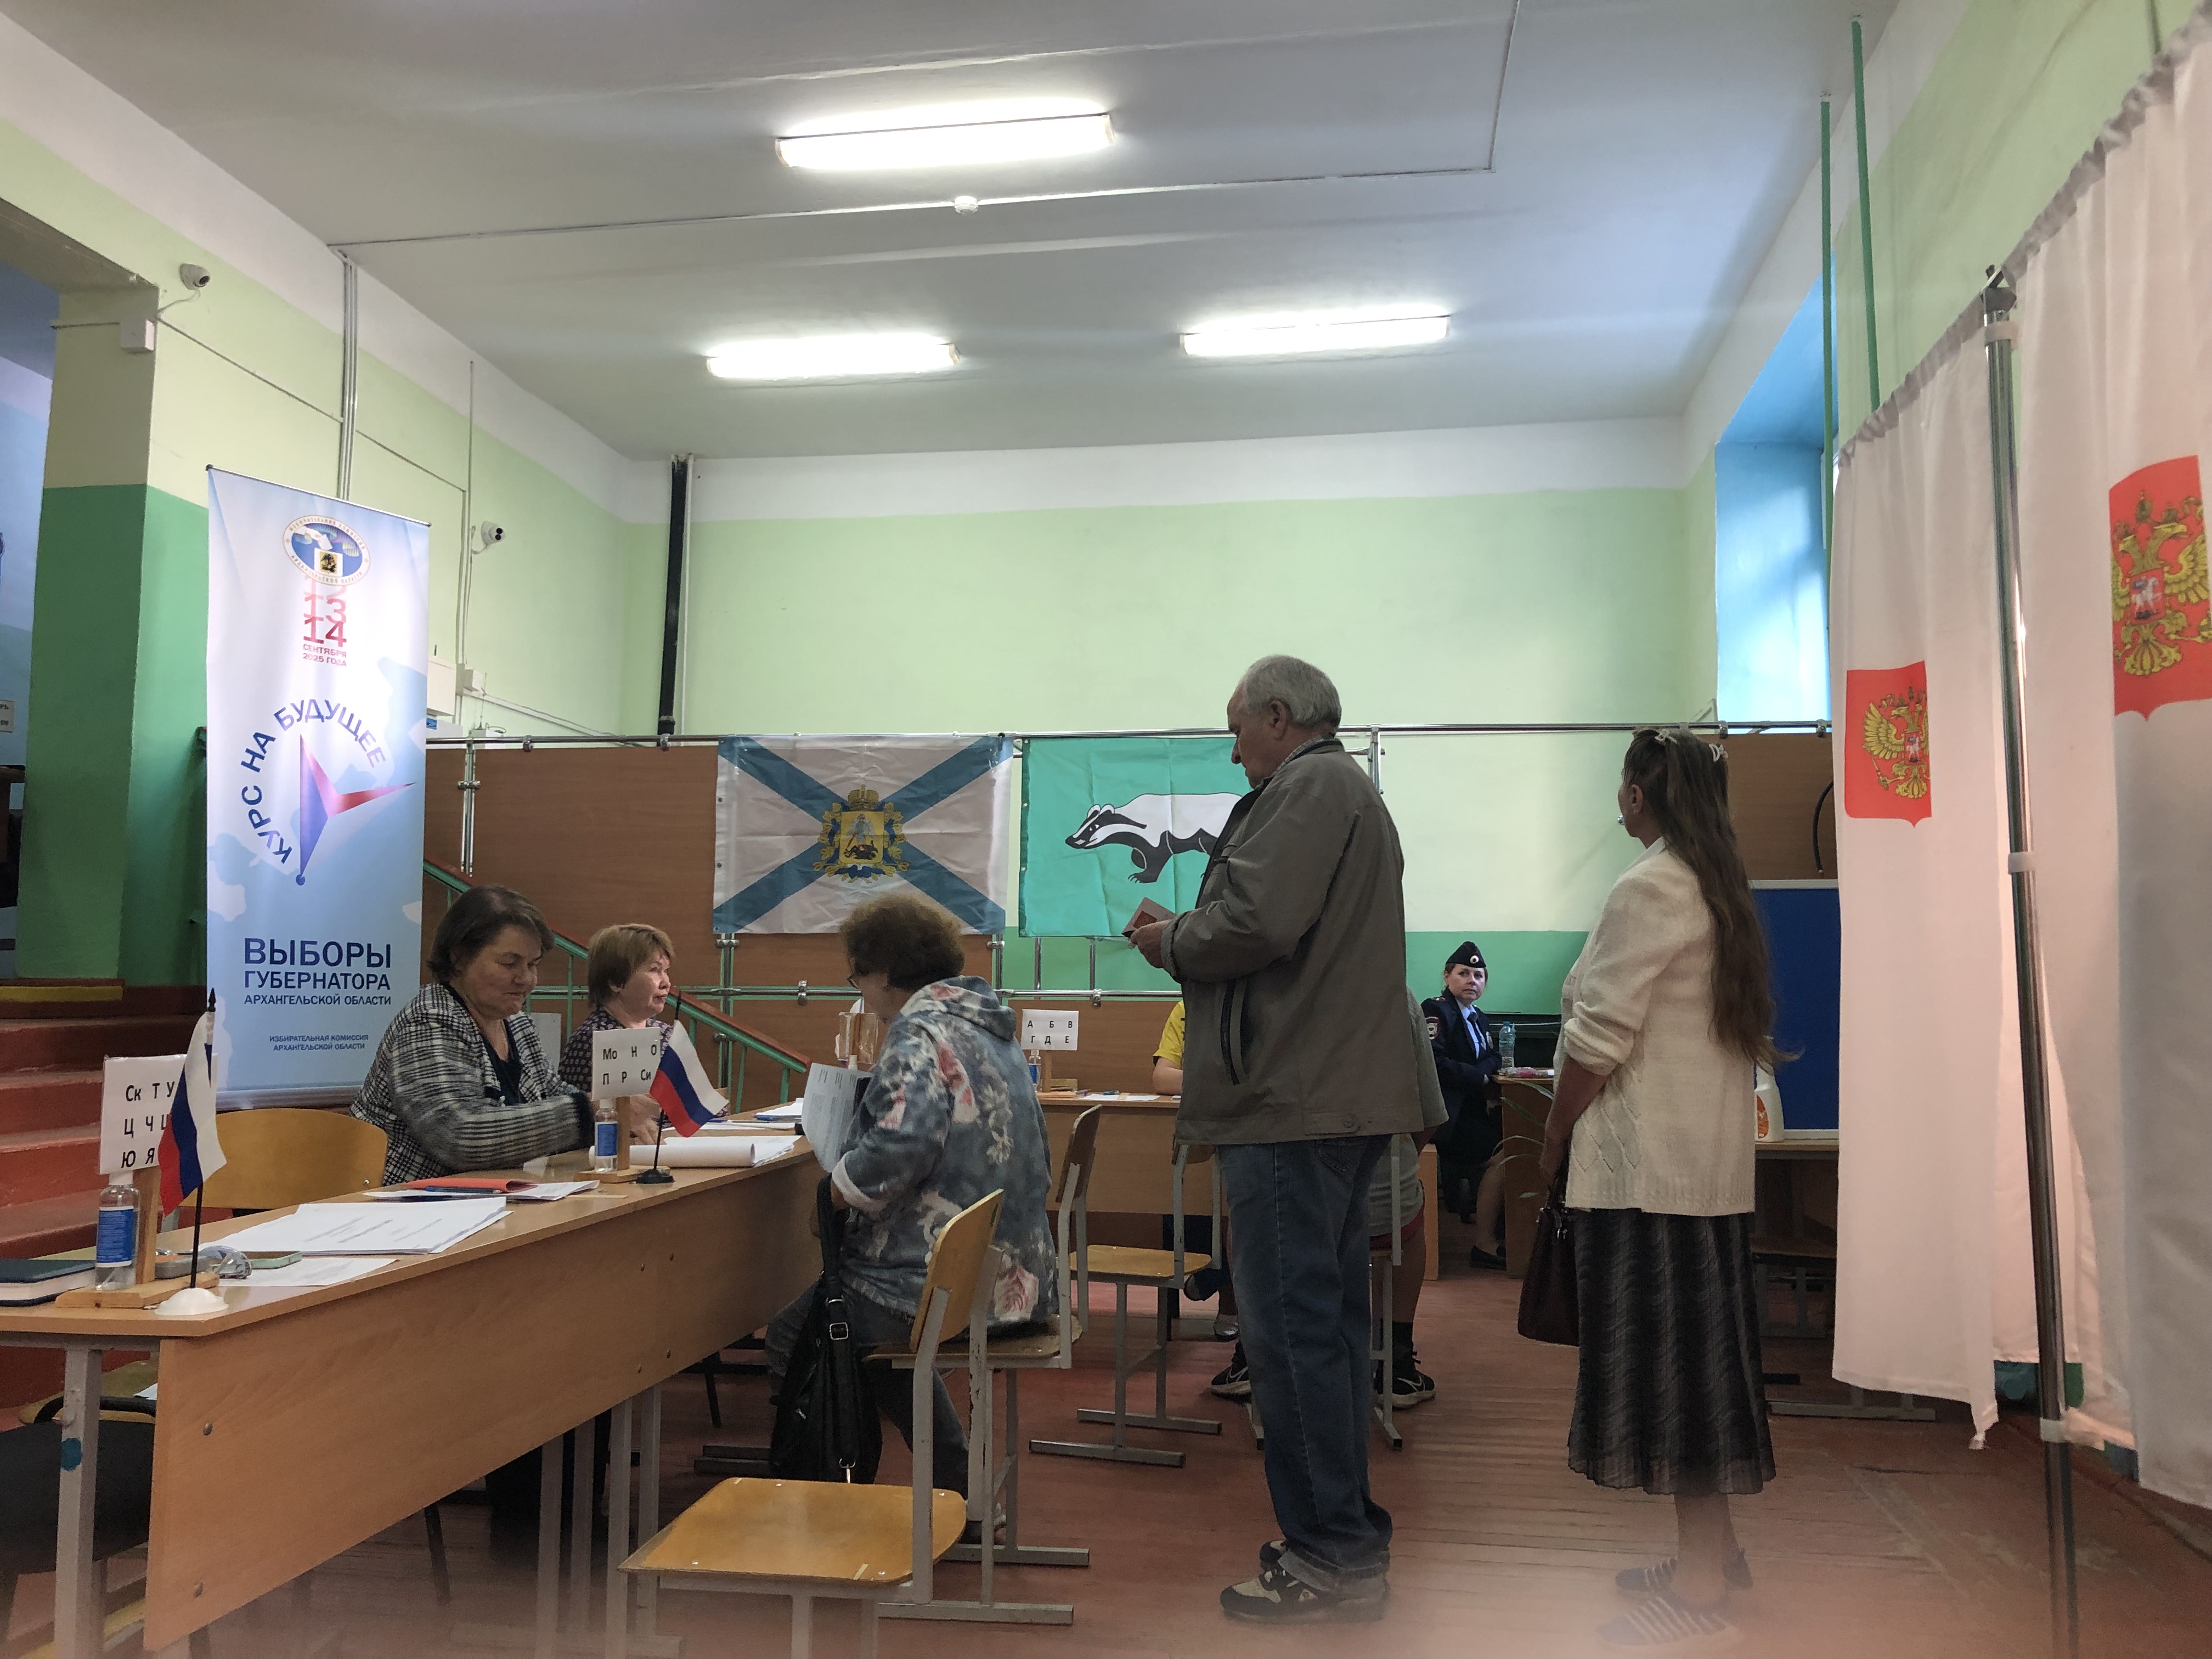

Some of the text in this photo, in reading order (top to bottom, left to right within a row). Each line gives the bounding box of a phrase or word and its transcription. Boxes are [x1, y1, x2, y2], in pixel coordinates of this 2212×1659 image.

[303, 616, 347, 647] 14
[303, 644, 347, 658] СЕНТЯБРЯ
[303, 652, 347, 667] 2025 ГОДА
[240, 698, 386, 864] КУРС НА БУДУЩЕЕ
[244, 938, 391, 968] ВЫБОРЫ
[244, 970, 391, 990] ГУБЕРНАТОРА
[244, 994, 391, 1006] АРХАНГЕЛЬСКОЙ ОБЛАСТИ
[273, 1043, 333, 1051] АРХАНГЕЛЬСКОЙ
[1045, 1036, 1051, 1045] Д
[603, 1045, 657, 1059] Мо Н О
[603, 1069, 651, 1085] П Р Си
[126, 1081, 175, 1102] Ск Т У
[125, 1118, 134, 1138] Ц
[146, 1116, 154, 1132] Ч
[121, 1148, 155, 1169] Ю Я
